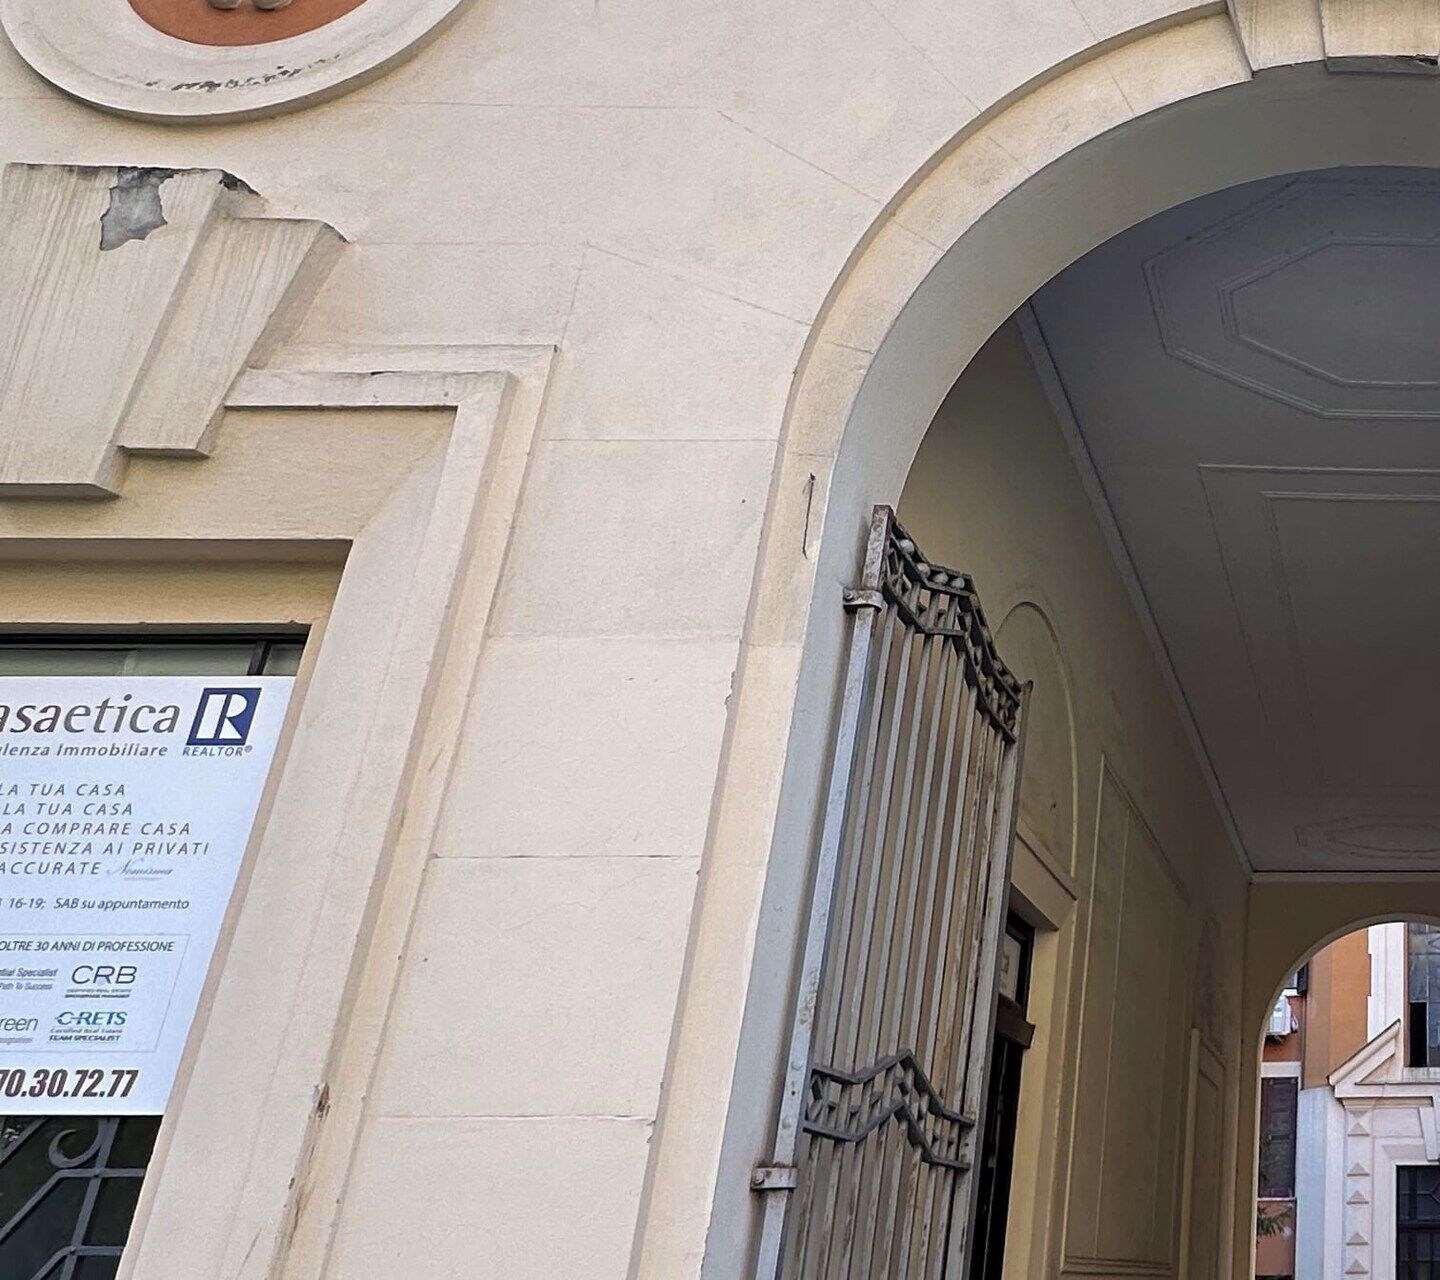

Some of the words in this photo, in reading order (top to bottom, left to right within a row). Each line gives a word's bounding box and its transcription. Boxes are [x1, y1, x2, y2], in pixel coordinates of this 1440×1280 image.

[0, 742, 50, 756] lenza
[56, 742, 169, 757] Immobiliare
[30, 783, 65, 796] TUA
[76, 783, 126, 796] CASA
[3, 802, 25, 816] LA
[37, 802, 72, 816] TUA
[83, 802, 133, 816] CASA
[1, 822, 12, 835] A
[23, 822, 131, 836] COMPRARE
[141, 822, 191, 836] CASA
[103, 841, 123, 855] AI
[132, 841, 210, 855] PRIVATI
[9, 897, 46, 910] 16-19;
[53, 897, 79, 909] SAB
[82, 900, 96, 910] su
[97, 898, 190, 912] appuntamento
[34, 940, 50, 951] 30
[50, 940, 81, 952] ANNI
[82, 940, 95, 952] DI
[97, 940, 175, 952] PROFESSIONE
[71, 965, 138, 985] CRB
